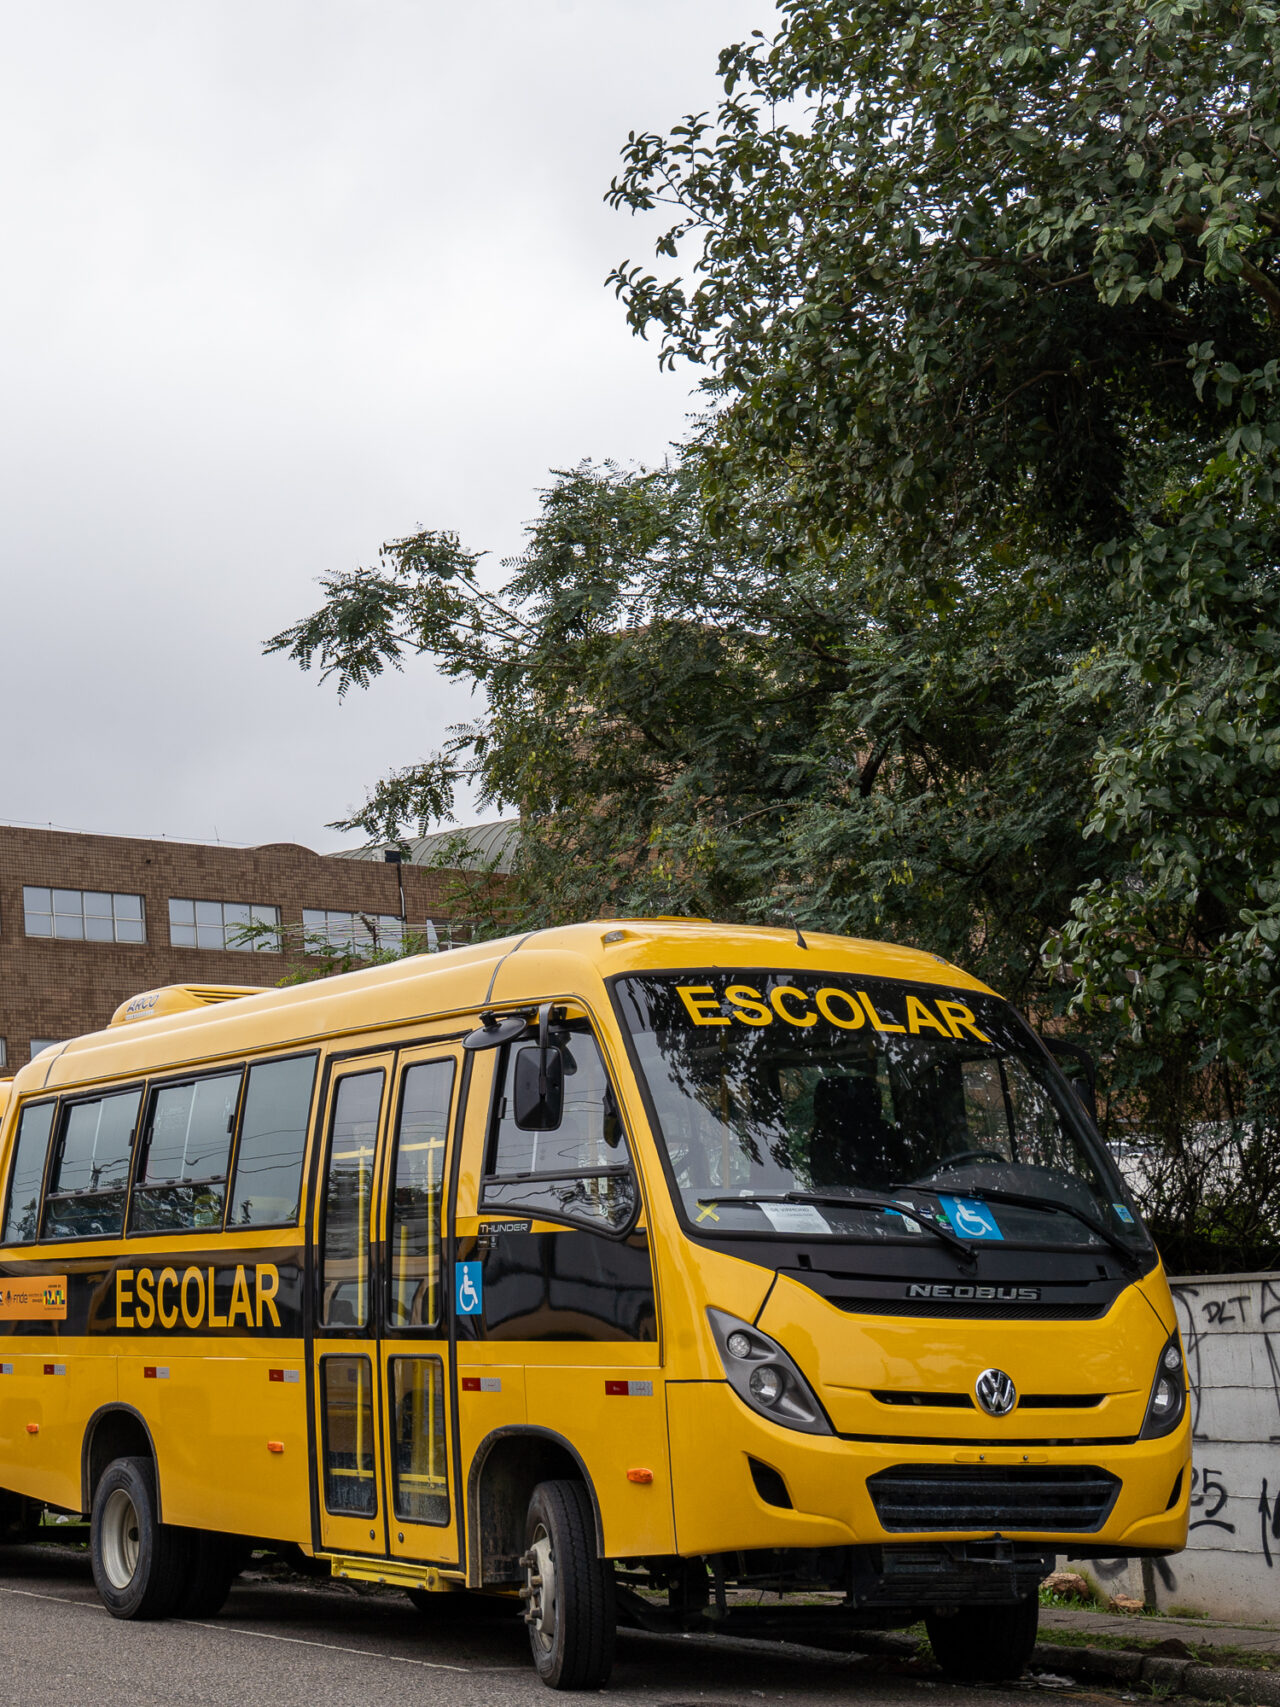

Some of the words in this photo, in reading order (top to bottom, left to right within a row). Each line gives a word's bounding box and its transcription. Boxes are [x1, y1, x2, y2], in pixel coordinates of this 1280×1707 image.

[126, 994, 160, 1013] ARCO
[675, 985, 992, 1043] ESCOLAR
[480, 1223, 528, 1233] THUNDER
[116, 1263, 282, 1329] ESCOLAR
[909, 1284, 1037, 1300] NEOBUS
[1202, 1296, 1251, 1325] DLT
